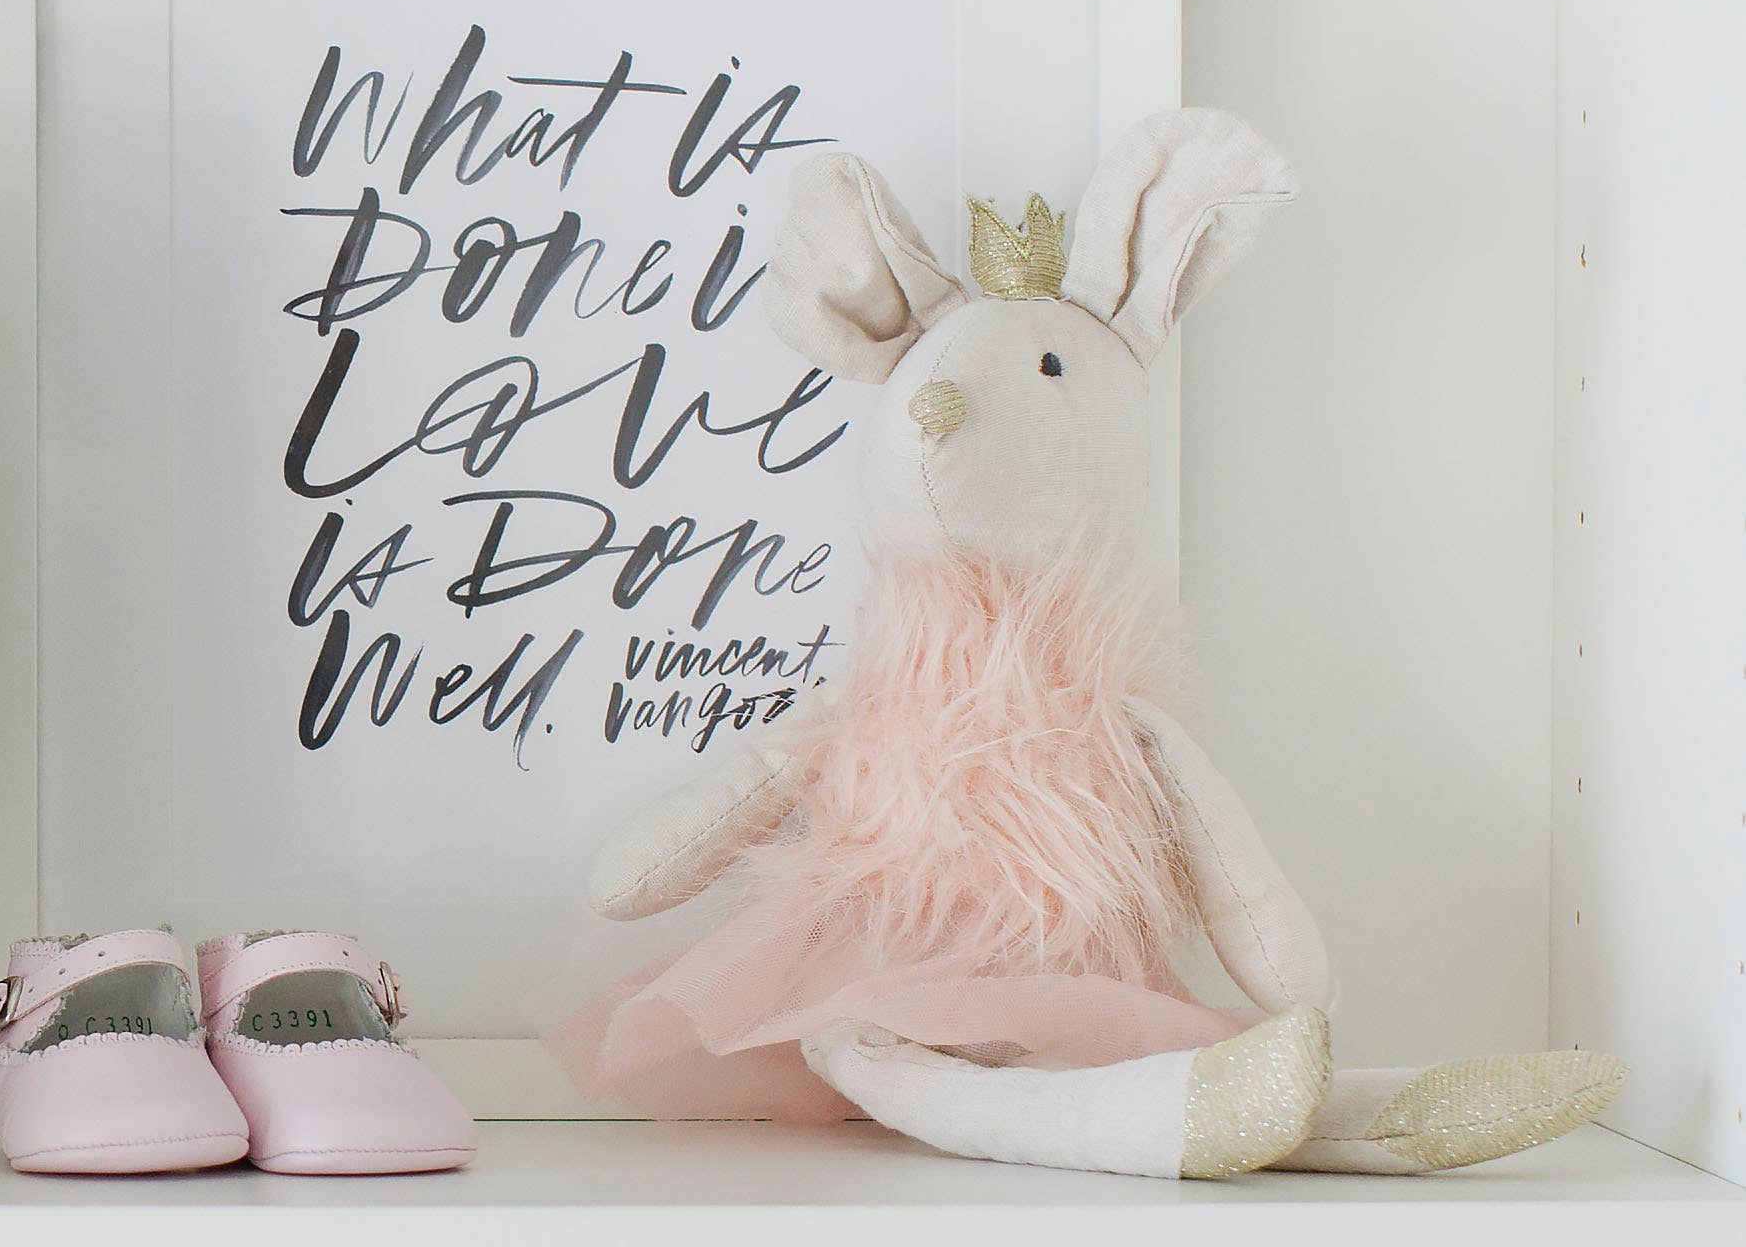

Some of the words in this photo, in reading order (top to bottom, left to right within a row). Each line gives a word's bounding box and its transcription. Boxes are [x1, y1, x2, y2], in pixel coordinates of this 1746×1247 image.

[292, 23, 688, 196] What
[667, 55, 840, 198] is
[690, 203, 770, 333] i
[287, 497, 435, 628] is
[252, 1008, 334, 1033] C3391
